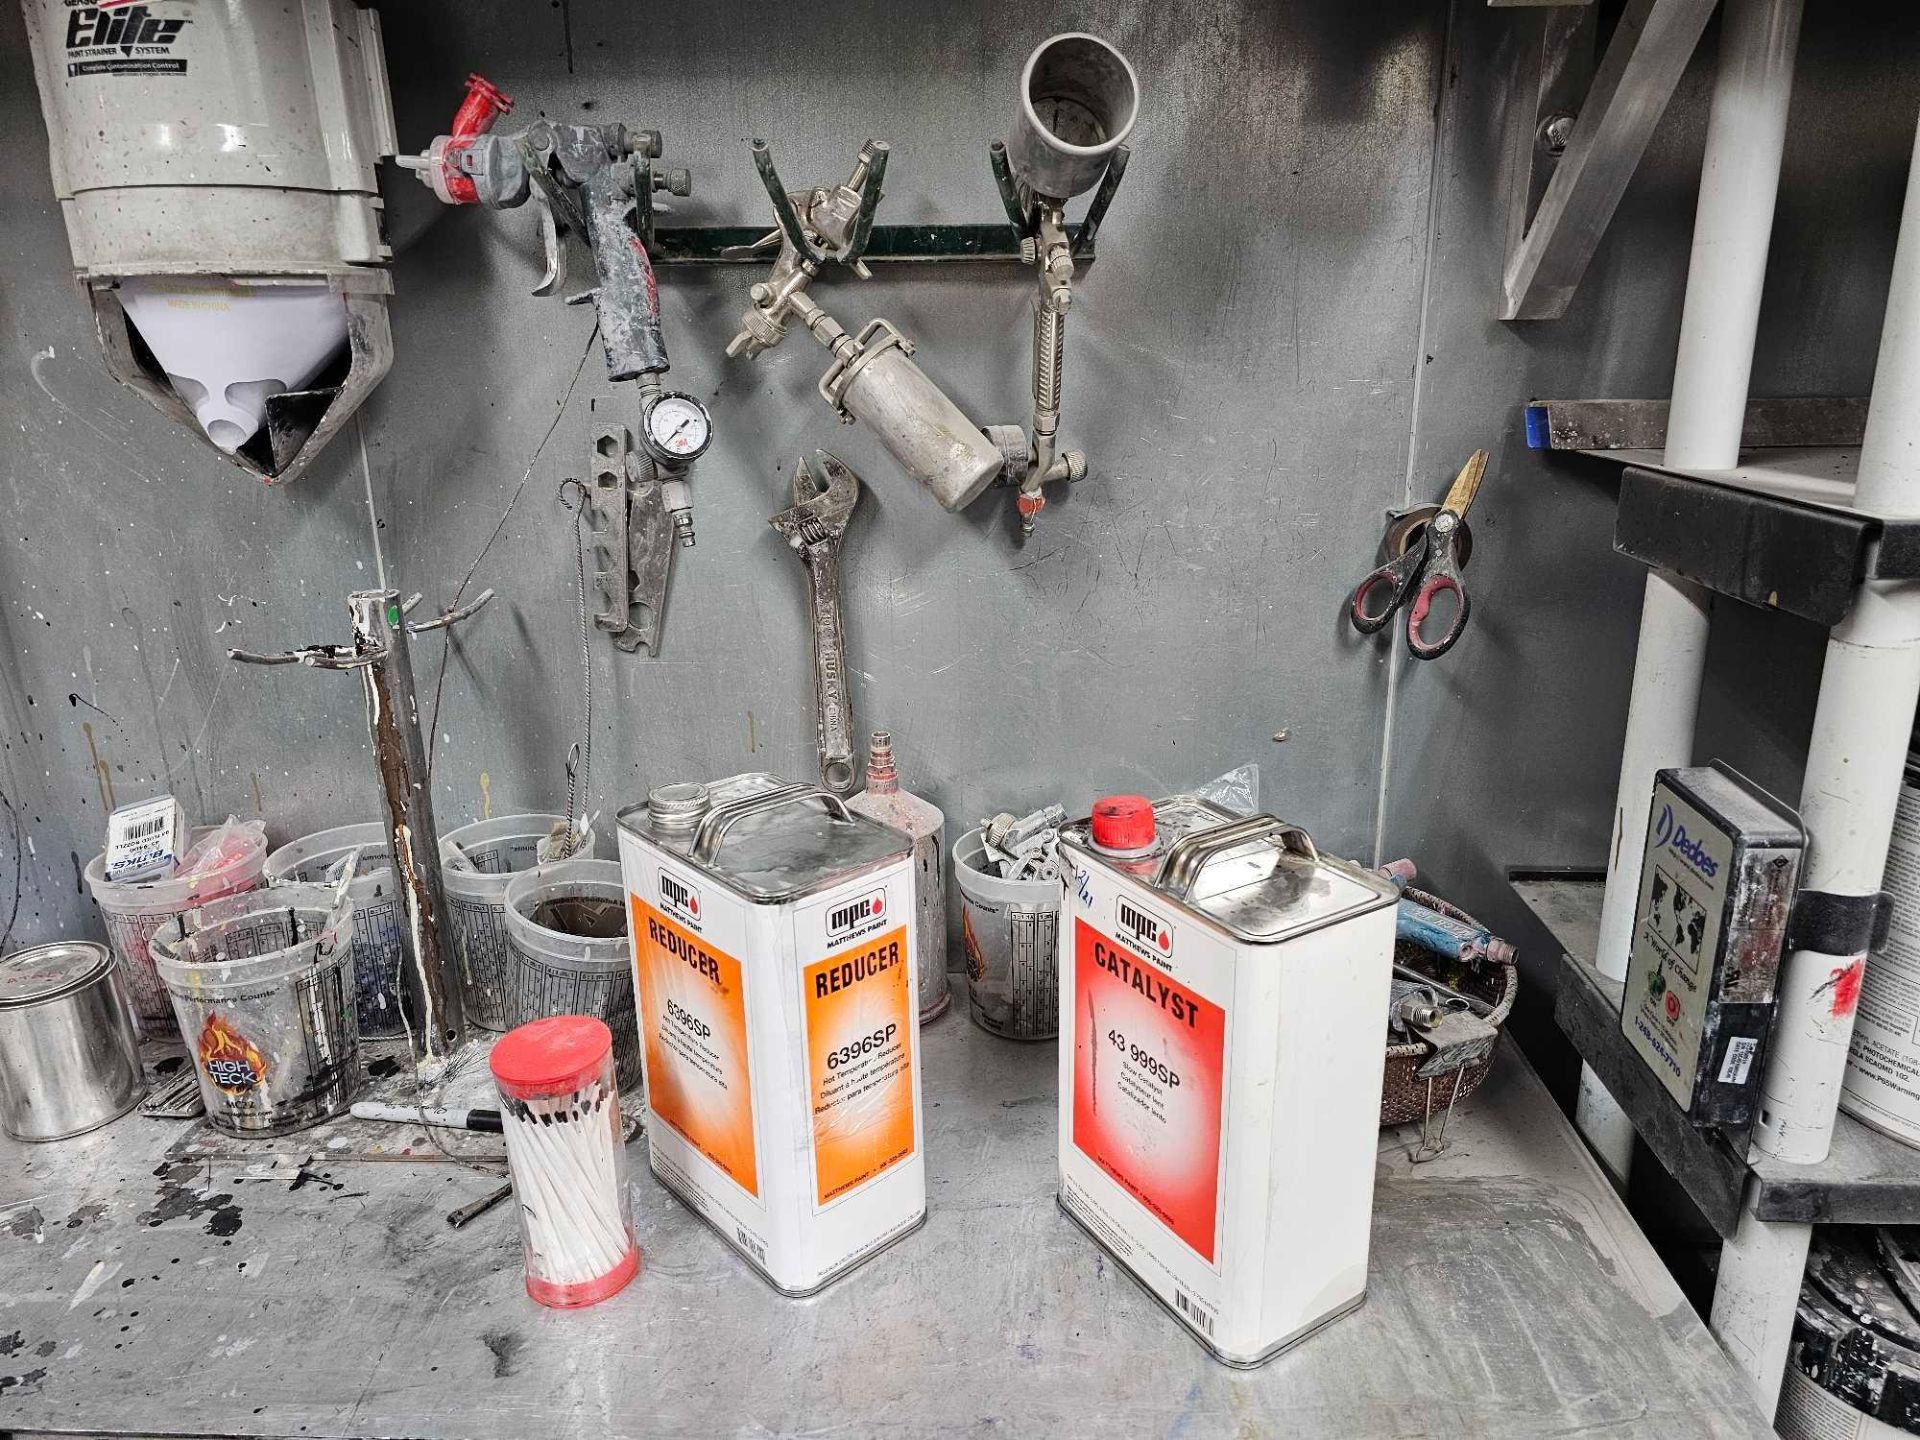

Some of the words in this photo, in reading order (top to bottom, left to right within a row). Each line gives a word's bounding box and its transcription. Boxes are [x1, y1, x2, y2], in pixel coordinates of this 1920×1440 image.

[135, 46, 170, 55] SYSTEM
[152, 61, 180, 70] Control
[661, 875, 689, 909] mpc
[831, 898, 871, 930] mpc
[1120, 903, 1157, 943] mpc
[648, 916, 720, 985] REDUCER
[827, 928, 866, 949] MATTHEWS
[867, 919, 888, 933] PAINT
[1115, 931, 1151, 960] MATTHEWS
[1152, 954, 1172, 973] PAINT
[815, 941, 899, 999] REDUCER
[1094, 942, 1199, 1028] CATALYST
[667, 998, 711, 1040] 6396SP
[826, 1023, 897, 1070] 6396SP
[1108, 1029, 1126, 1052] 43
[1130, 1043, 1181, 1089] 999SP
[1872, 1040, 1900, 1059] ACETATE
[208, 1060, 250, 1072] HIGH
[209, 1071, 258, 1084] TECK
[822, 1075, 836, 1086] Hot
[877, 1043, 902, 1058] Reducer
[1122, 1061, 1137, 1076] Slow
[847, 1088, 862, 1101] para
